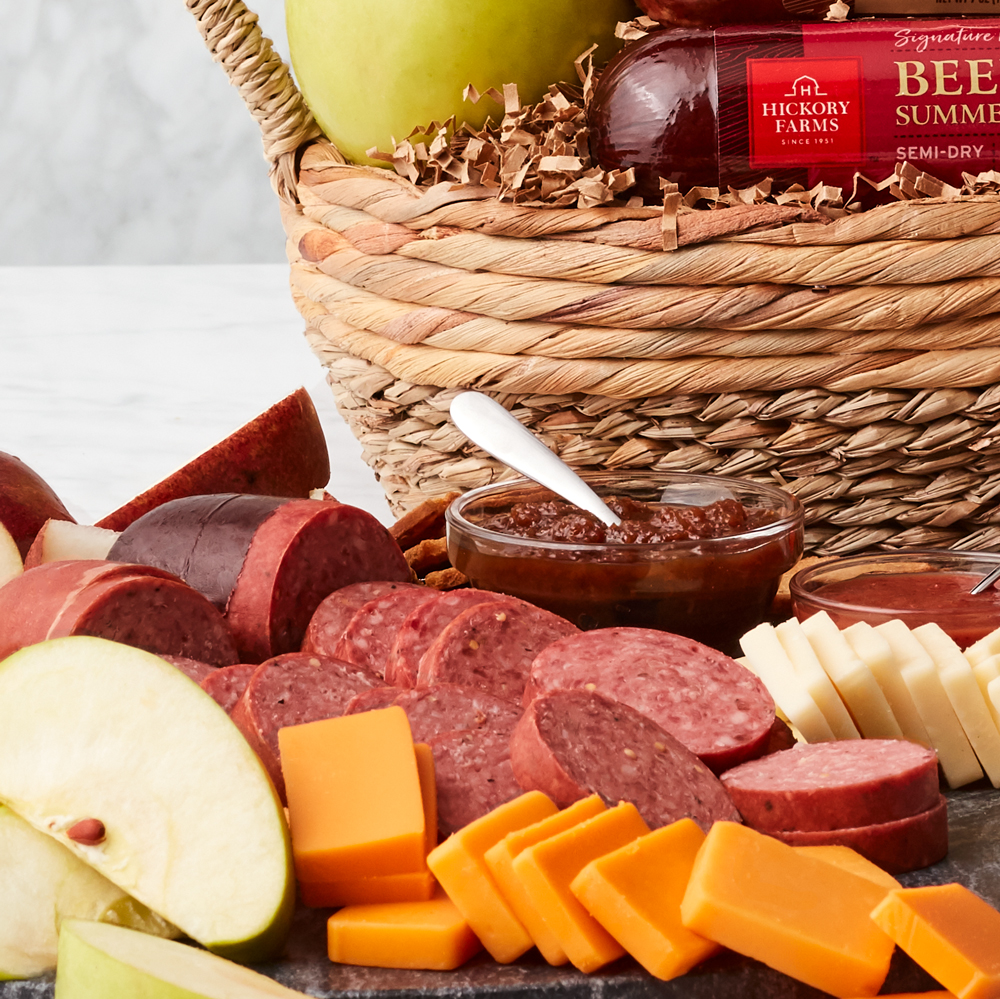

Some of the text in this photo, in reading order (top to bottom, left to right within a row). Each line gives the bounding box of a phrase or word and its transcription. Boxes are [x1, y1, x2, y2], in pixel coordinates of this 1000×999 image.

[894, 28, 995, 53] Signature
[801, 85, 811, 96] H
[762, 101, 850, 117] HICKORY
[775, 118, 839, 133] FARMS
[896, 145, 985, 160] SEMI-DRY
